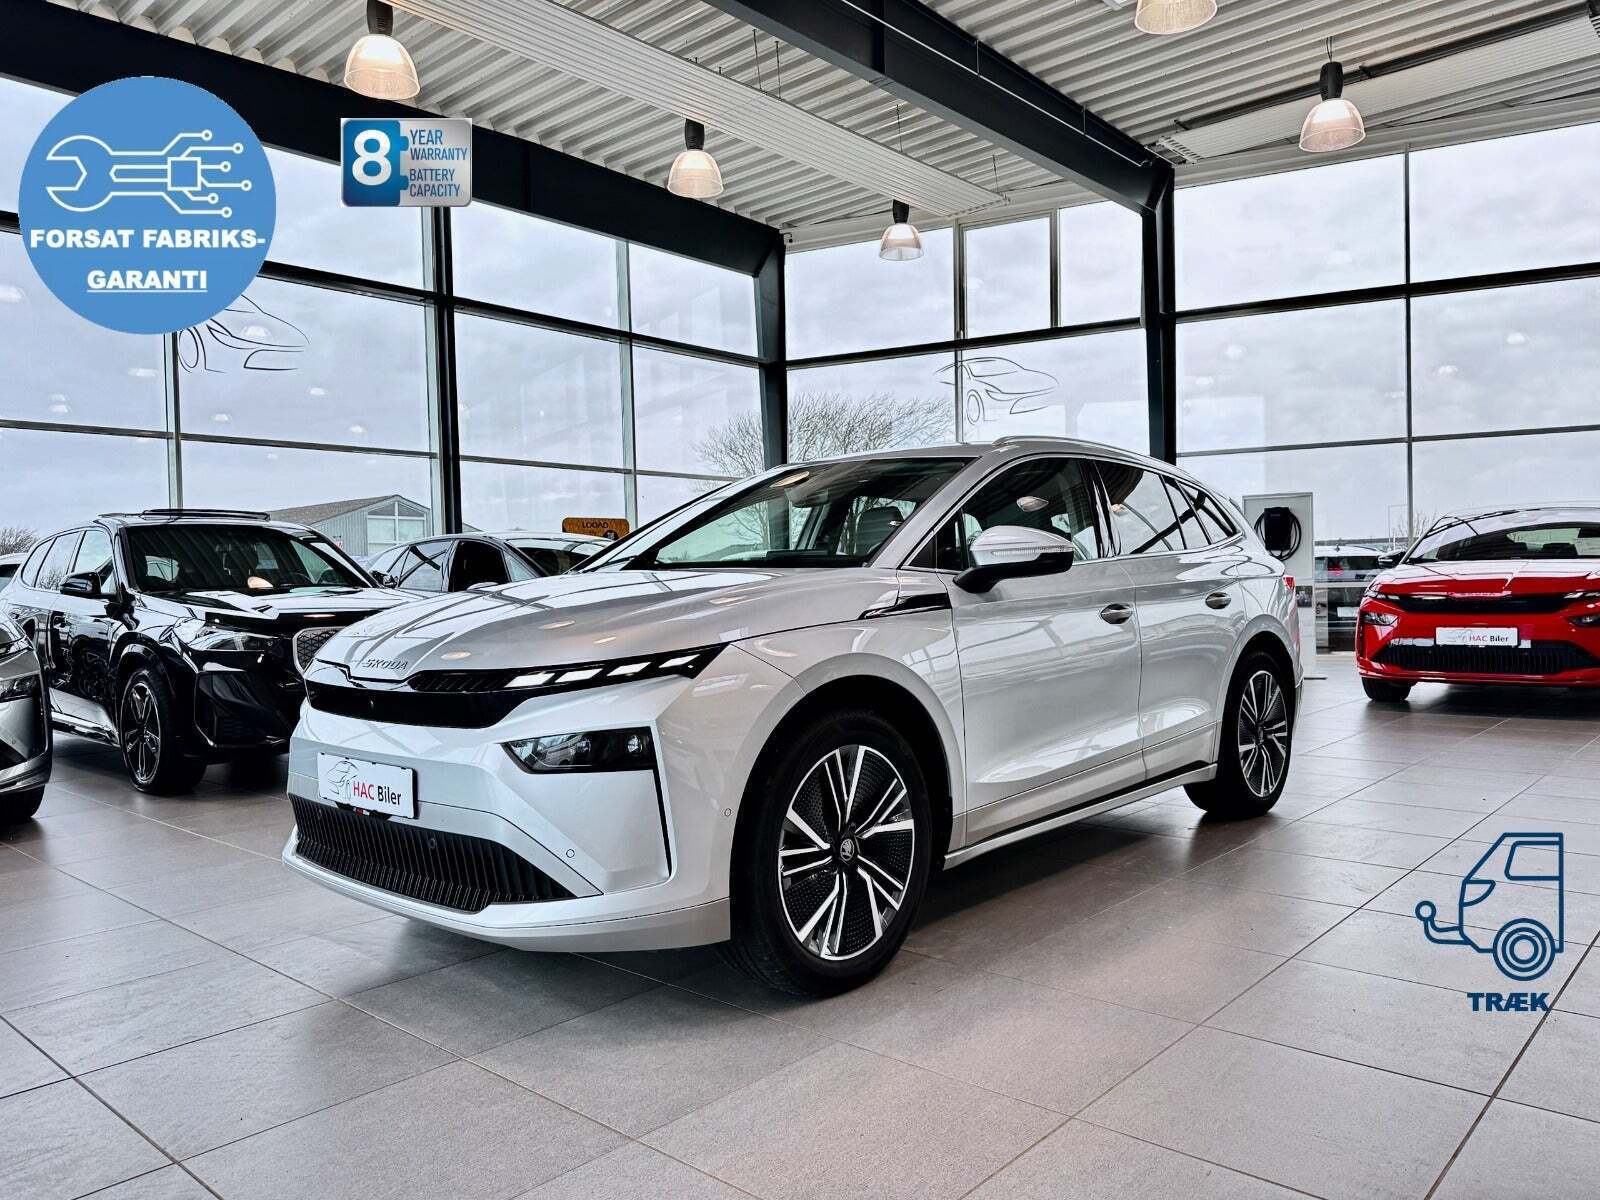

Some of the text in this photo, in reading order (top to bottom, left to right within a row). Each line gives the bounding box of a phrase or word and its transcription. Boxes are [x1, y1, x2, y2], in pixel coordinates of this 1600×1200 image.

[1469, 634, 1509, 643] HAC Biler
[353, 780, 402, 806] HAC Biler
